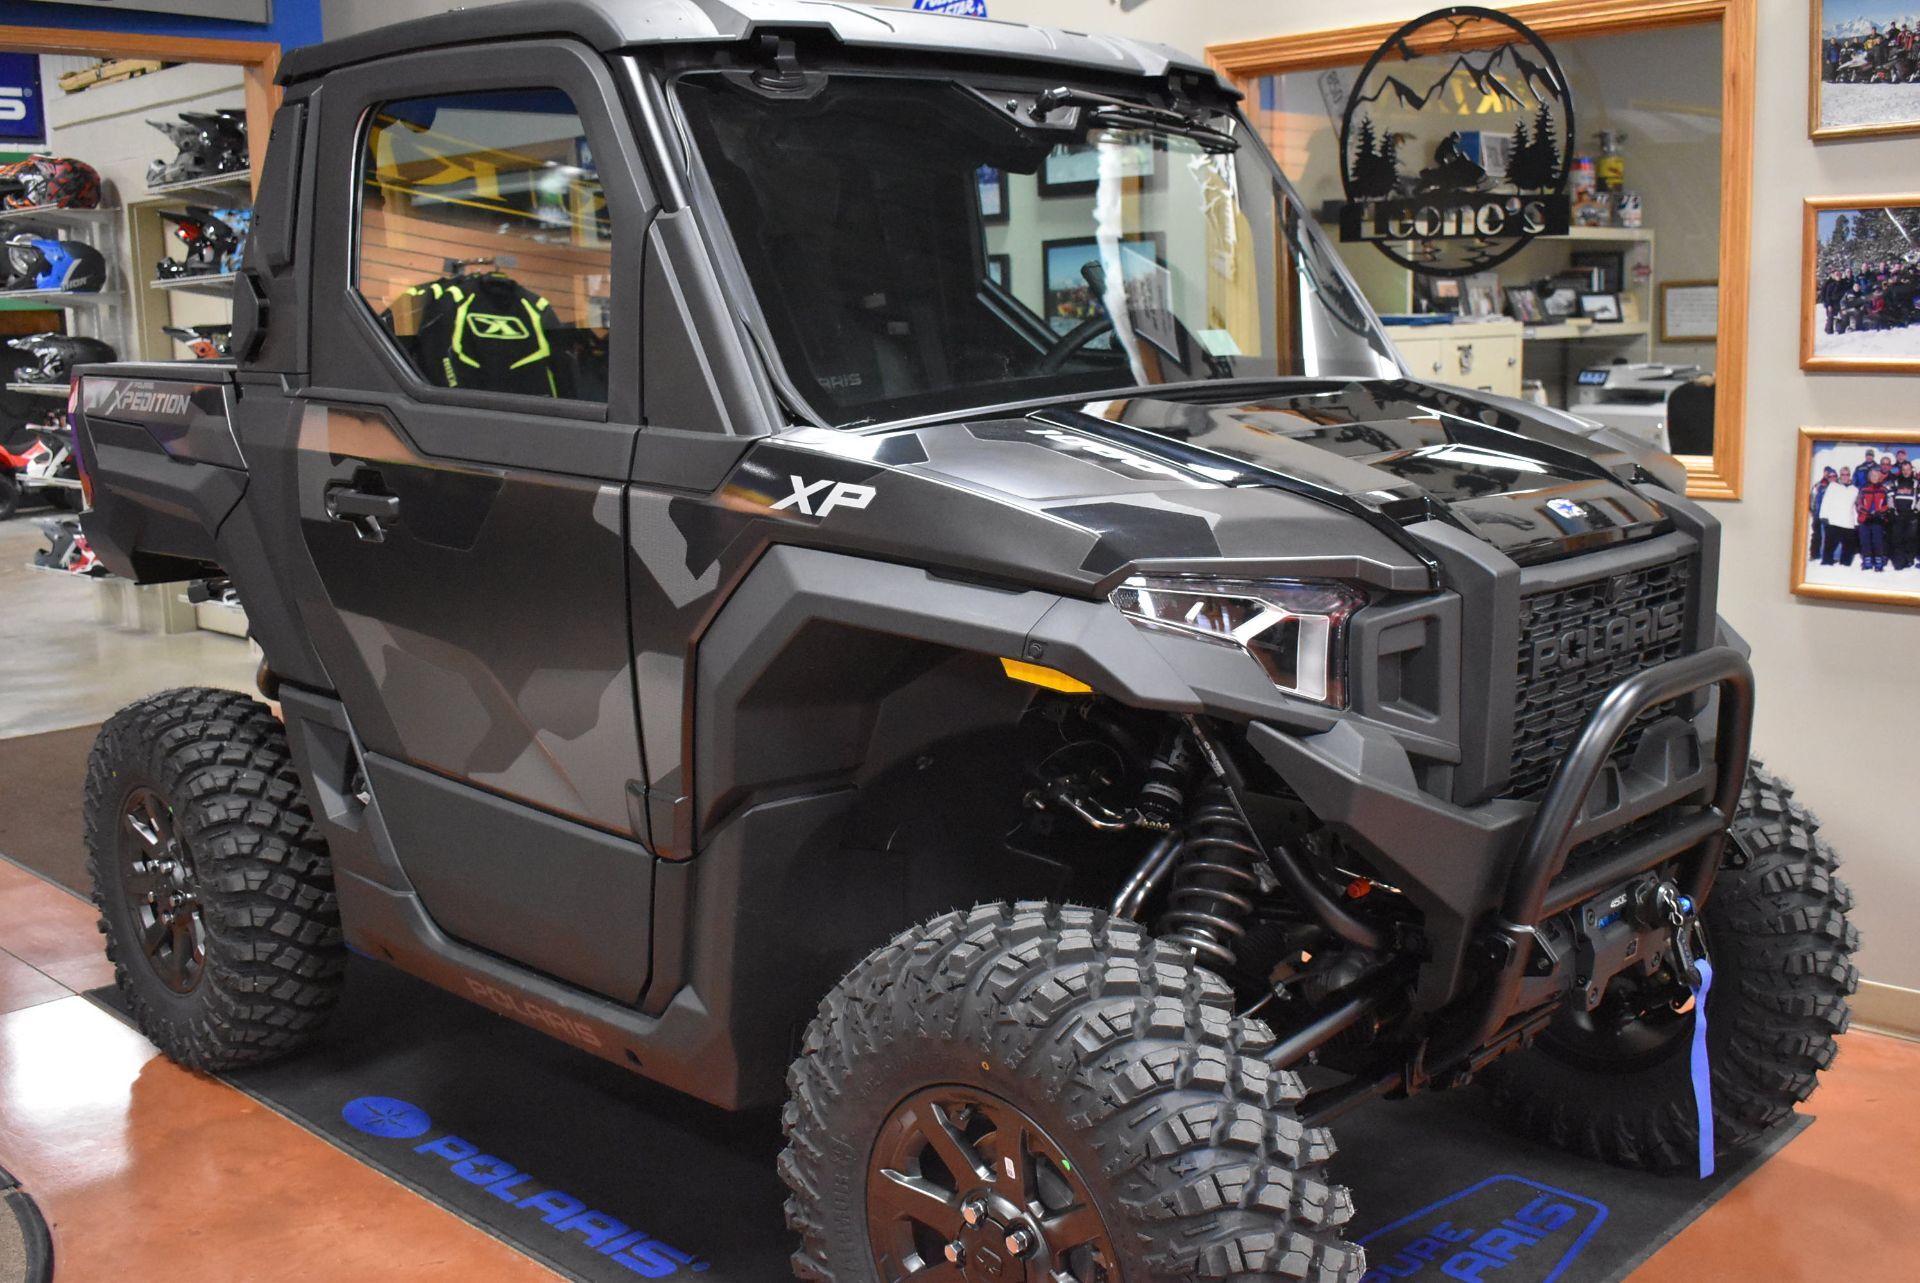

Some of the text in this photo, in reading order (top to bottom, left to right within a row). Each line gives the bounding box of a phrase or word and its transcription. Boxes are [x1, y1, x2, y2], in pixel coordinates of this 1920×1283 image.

[1360, 196, 1546, 239] Leone's
[104, 385, 191, 415] XPEDITION
[768, 474, 877, 517] XP
[1532, 599, 1684, 681] POLARIS
[464, 976, 603, 1048] POLARIS
[413, 1135, 694, 1279] POLARIS
